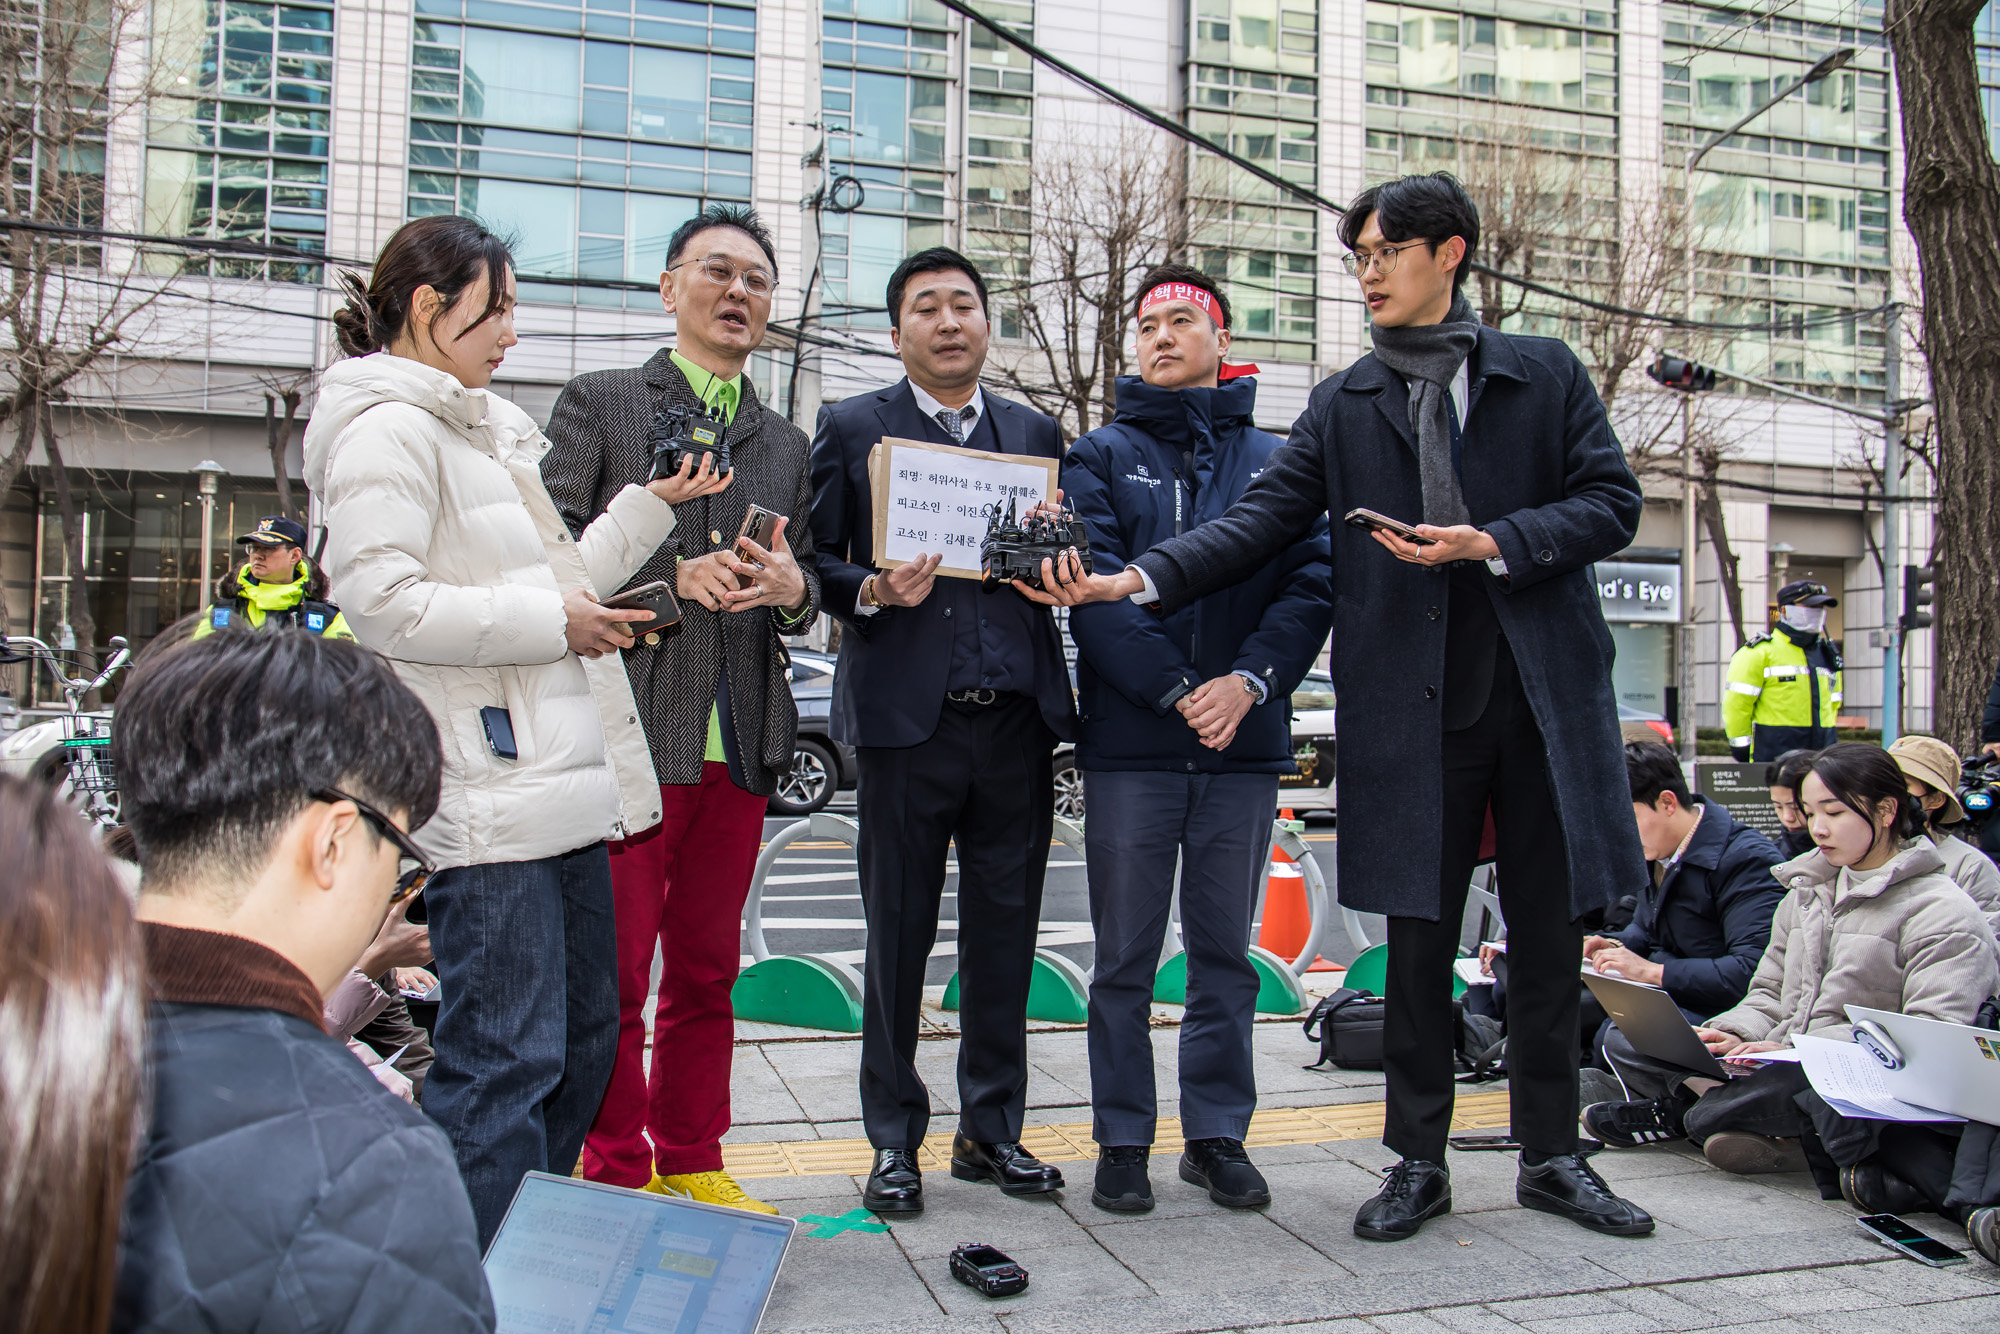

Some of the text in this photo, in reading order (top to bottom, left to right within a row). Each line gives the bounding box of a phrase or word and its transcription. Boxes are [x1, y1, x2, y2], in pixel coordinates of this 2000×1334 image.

[898, 469, 923, 482] 죄명:
[928, 473, 968, 489] 허위사실
[974, 480, 993, 492] 유포
[897, 497, 940, 514] 피고소인
[896, 527, 928, 542] 고소인
[944, 533, 977, 548] 김새론
[1639, 580, 1674, 604] Eye
